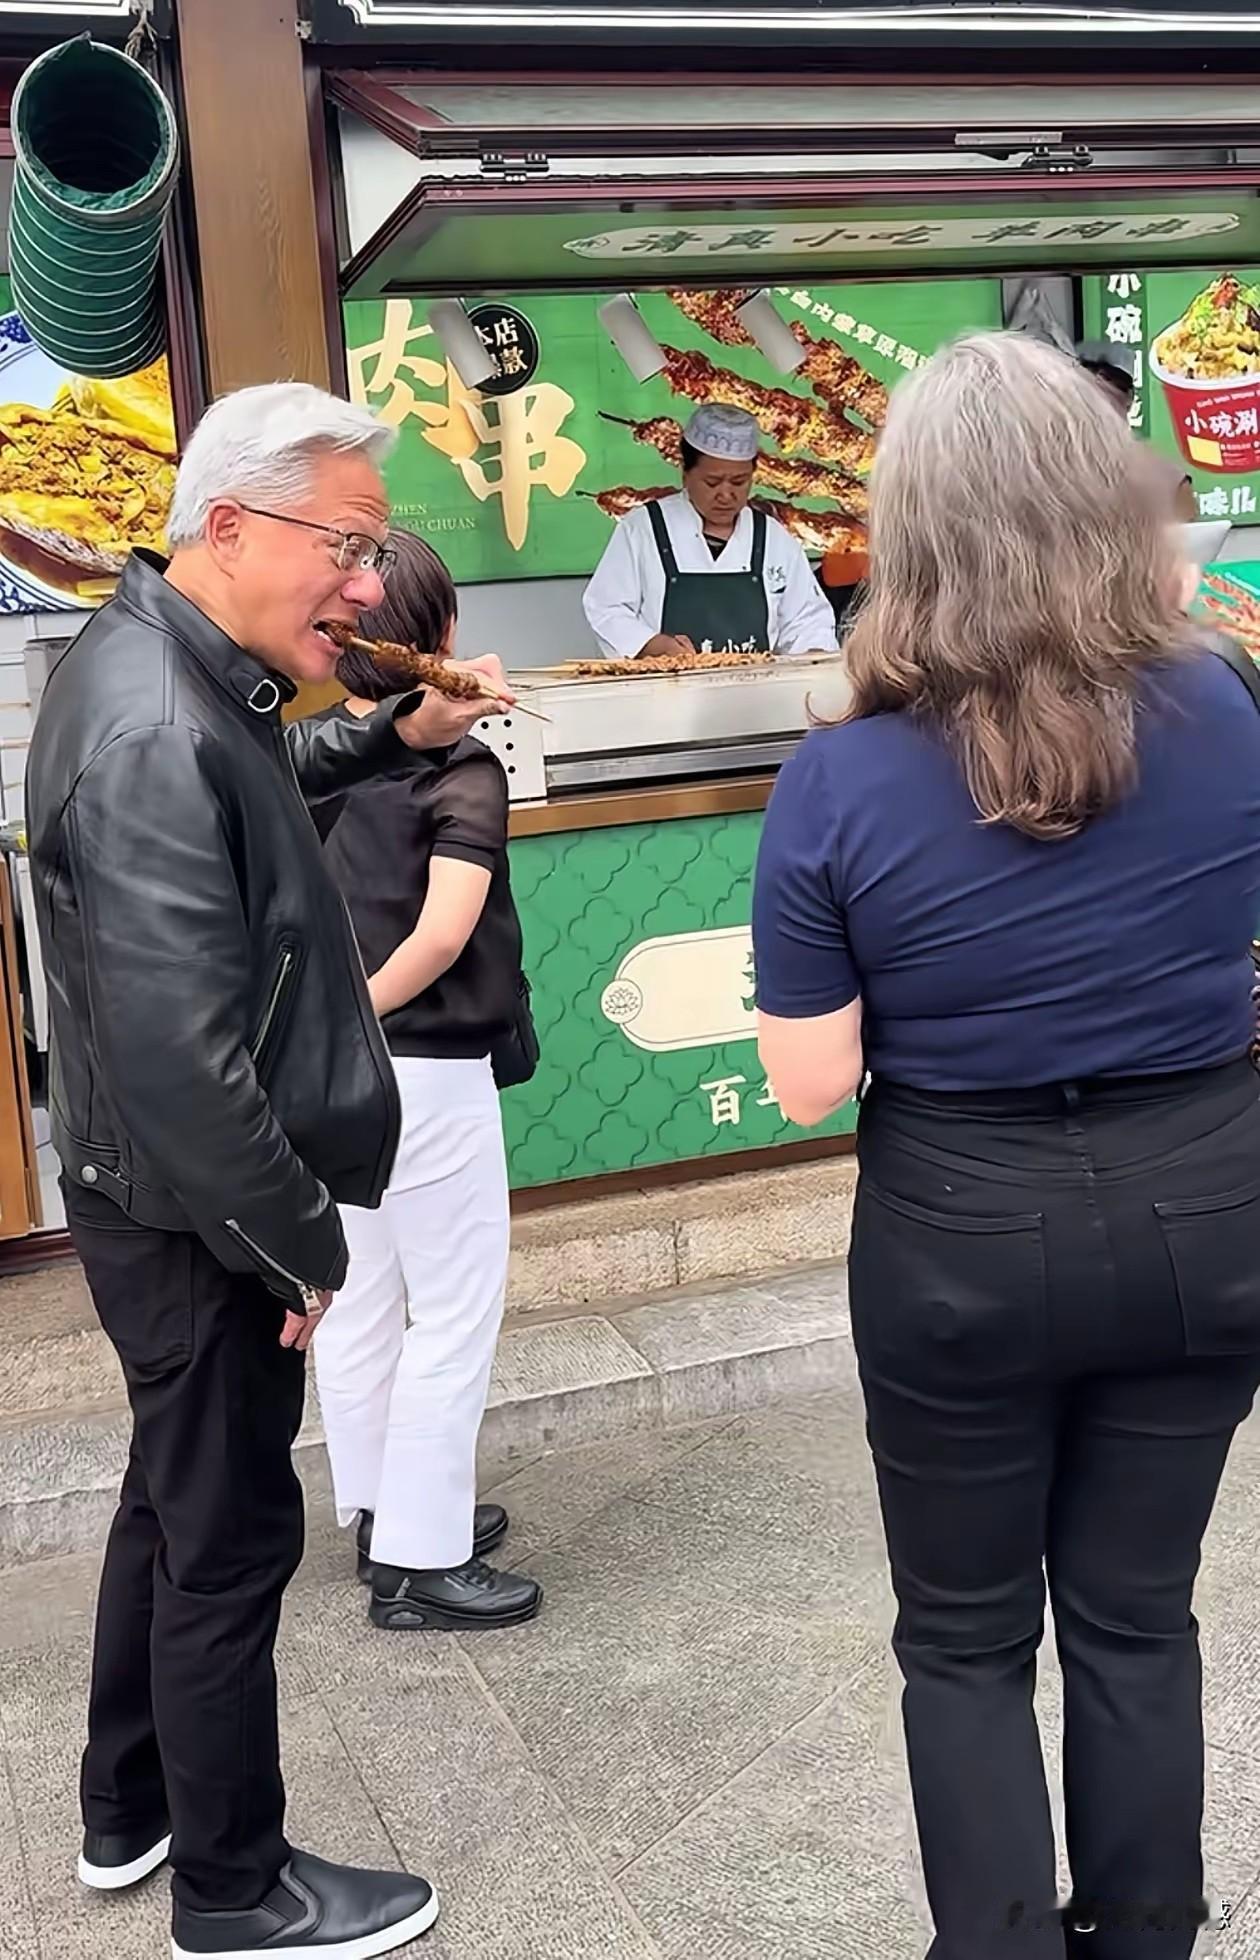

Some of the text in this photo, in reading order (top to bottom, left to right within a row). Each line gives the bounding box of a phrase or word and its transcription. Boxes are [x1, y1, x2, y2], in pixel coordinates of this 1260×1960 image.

[623, 225, 940, 253] 清真小吃
[1184, 408, 1258, 438] 小碗涮
[427, 517, 475, 532] CHUAN
